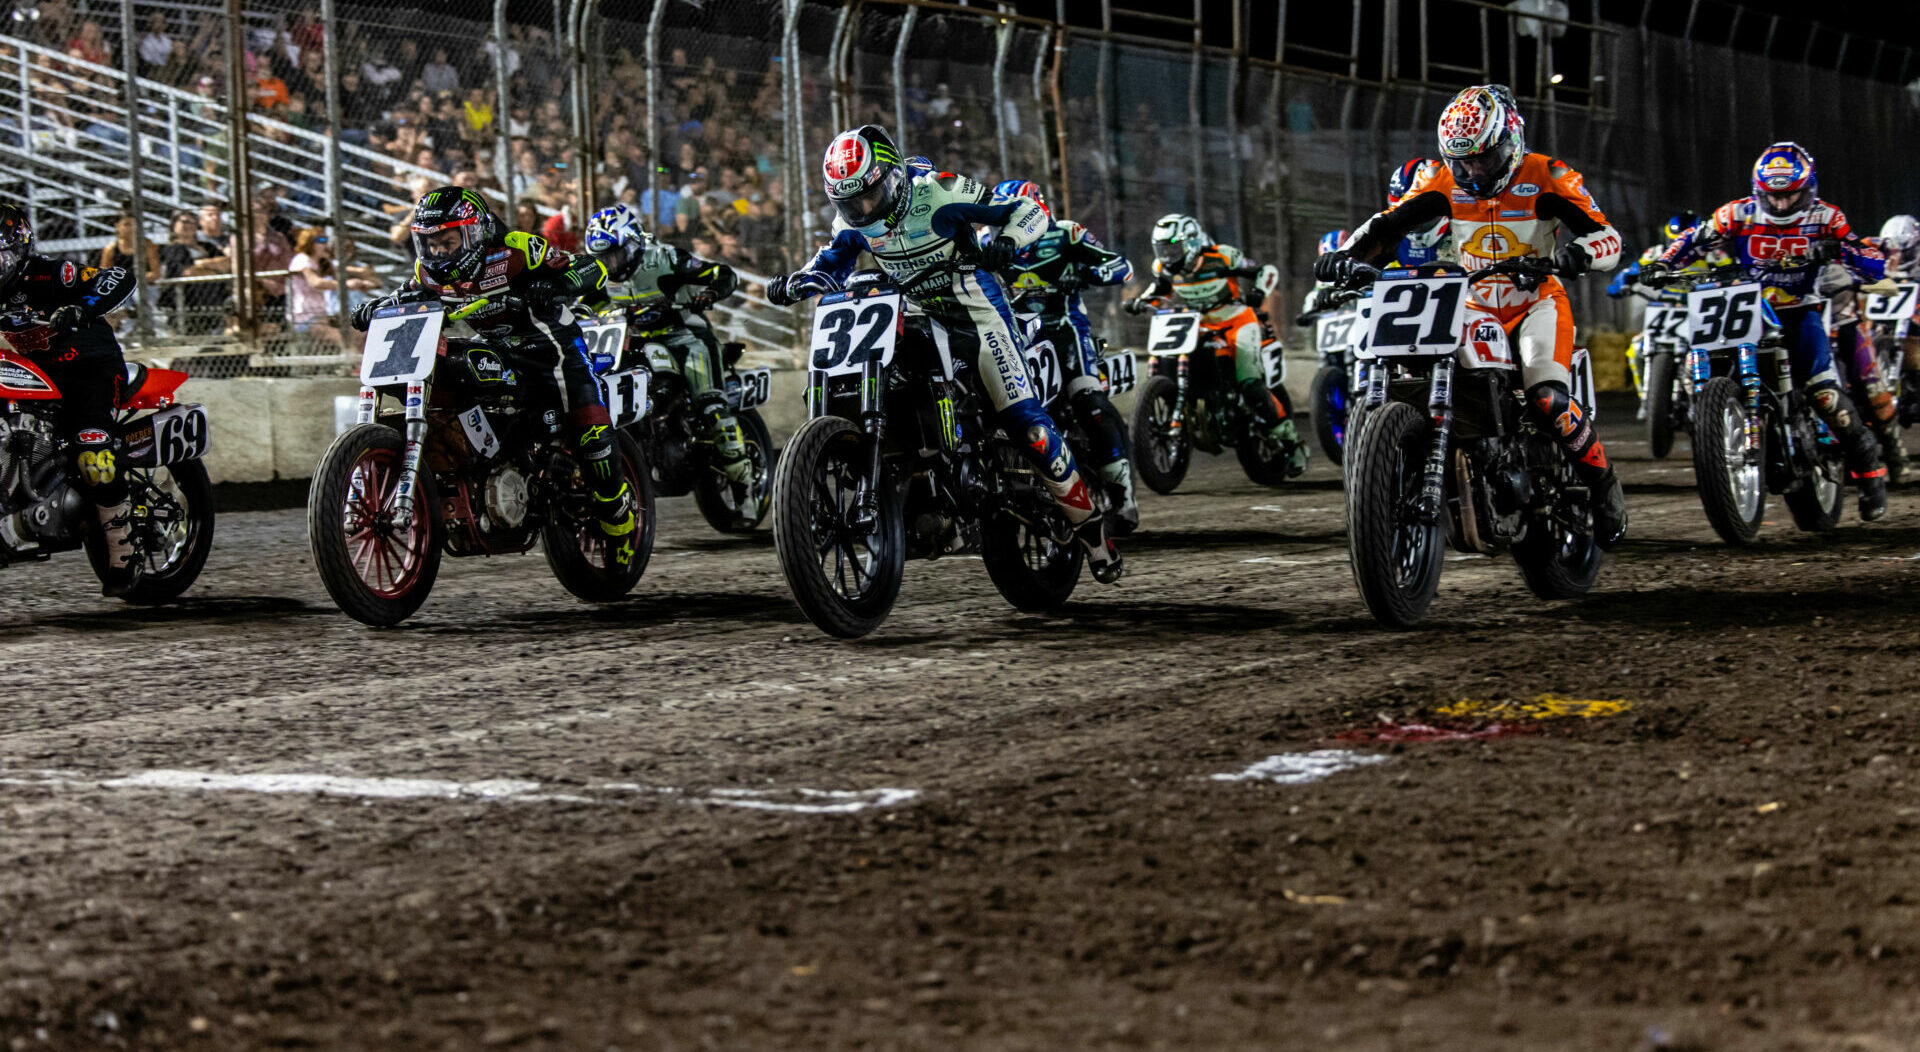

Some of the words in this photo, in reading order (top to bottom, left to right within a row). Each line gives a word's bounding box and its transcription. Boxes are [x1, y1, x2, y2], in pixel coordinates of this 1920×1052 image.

[1452, 138, 1470, 148] Arai
[840, 179, 858, 190] Arai
[1518, 184, 1537, 193] Arai
[1016, 204, 1041, 229] ESTENSON
[882, 250, 945, 271] ESTENSON
[1588, 235, 1620, 259] DID
[97, 266, 127, 295] cardo
[1372, 282, 1462, 347] 21
[1647, 310, 1689, 338] 47
[1692, 291, 1759, 345] 36
[369, 316, 429, 379] 1
[813, 303, 894, 369] 32
[1152, 317, 1195, 351] 3
[1320, 317, 1356, 348] 67
[1474, 325, 1498, 342] KTM
[984, 331, 1019, 400] ESTENSON
[1111, 354, 1135, 395] 44
[1268, 348, 1283, 386] 3
[360, 390, 374, 400] RK
[407, 385, 422, 395] RK
[617, 374, 637, 426] 1
[742, 371, 769, 409] 20
[1554, 400, 1583, 437] 21
[161, 409, 207, 466] 69
[78, 449, 117, 486] 69
